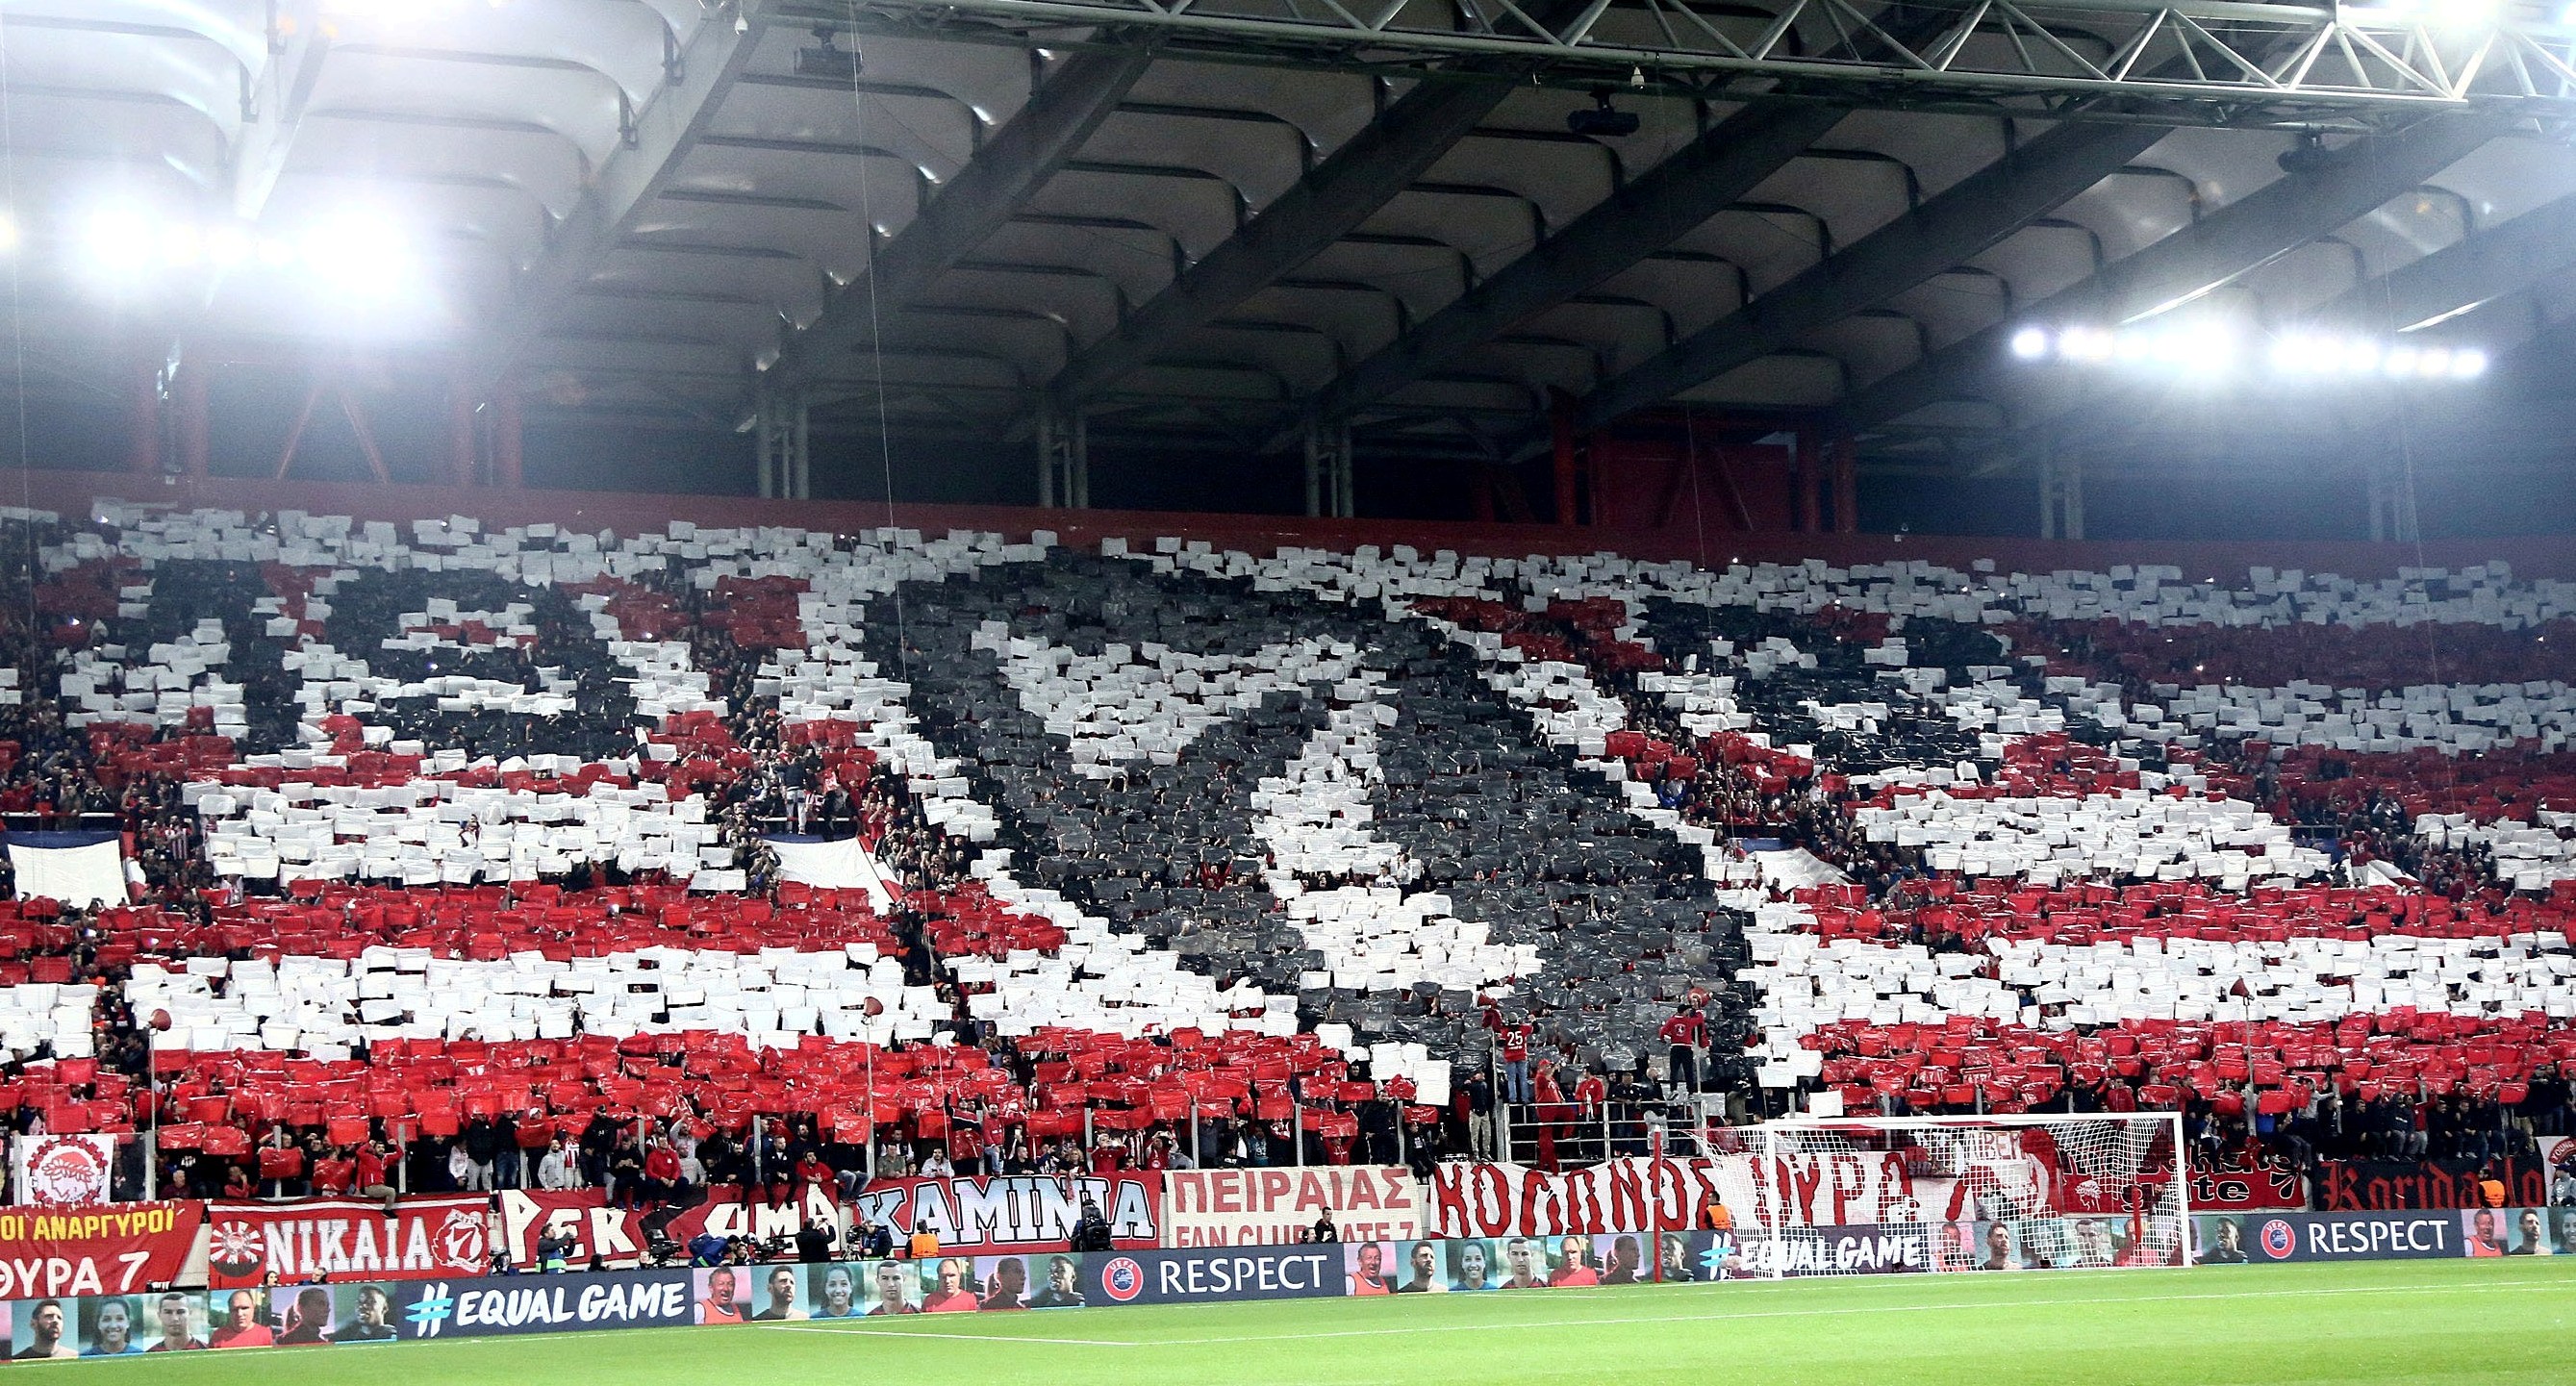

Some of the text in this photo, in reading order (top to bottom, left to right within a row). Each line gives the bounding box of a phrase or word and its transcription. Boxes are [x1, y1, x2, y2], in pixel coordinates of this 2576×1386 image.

[1506, 1030, 1524, 1046] 25
[2550, 1139, 2575, 1161] YOUNG
[1173, 1168, 1412, 1213] ΠΕΙΡΑΙΑΣ
[33, 1208, 174, 1241] ΑΝΑΡΓΥΡΟΙ
[1175, 1224, 1226, 1247] FAN
[2266, 1221, 2287, 1232] UEFA
[2308, 1219, 2449, 1254] RESPECT
[118, 1250, 150, 1293] 7
[1109, 1259, 1135, 1272] UEFA
[1159, 1254, 1328, 1295] RESPECT
